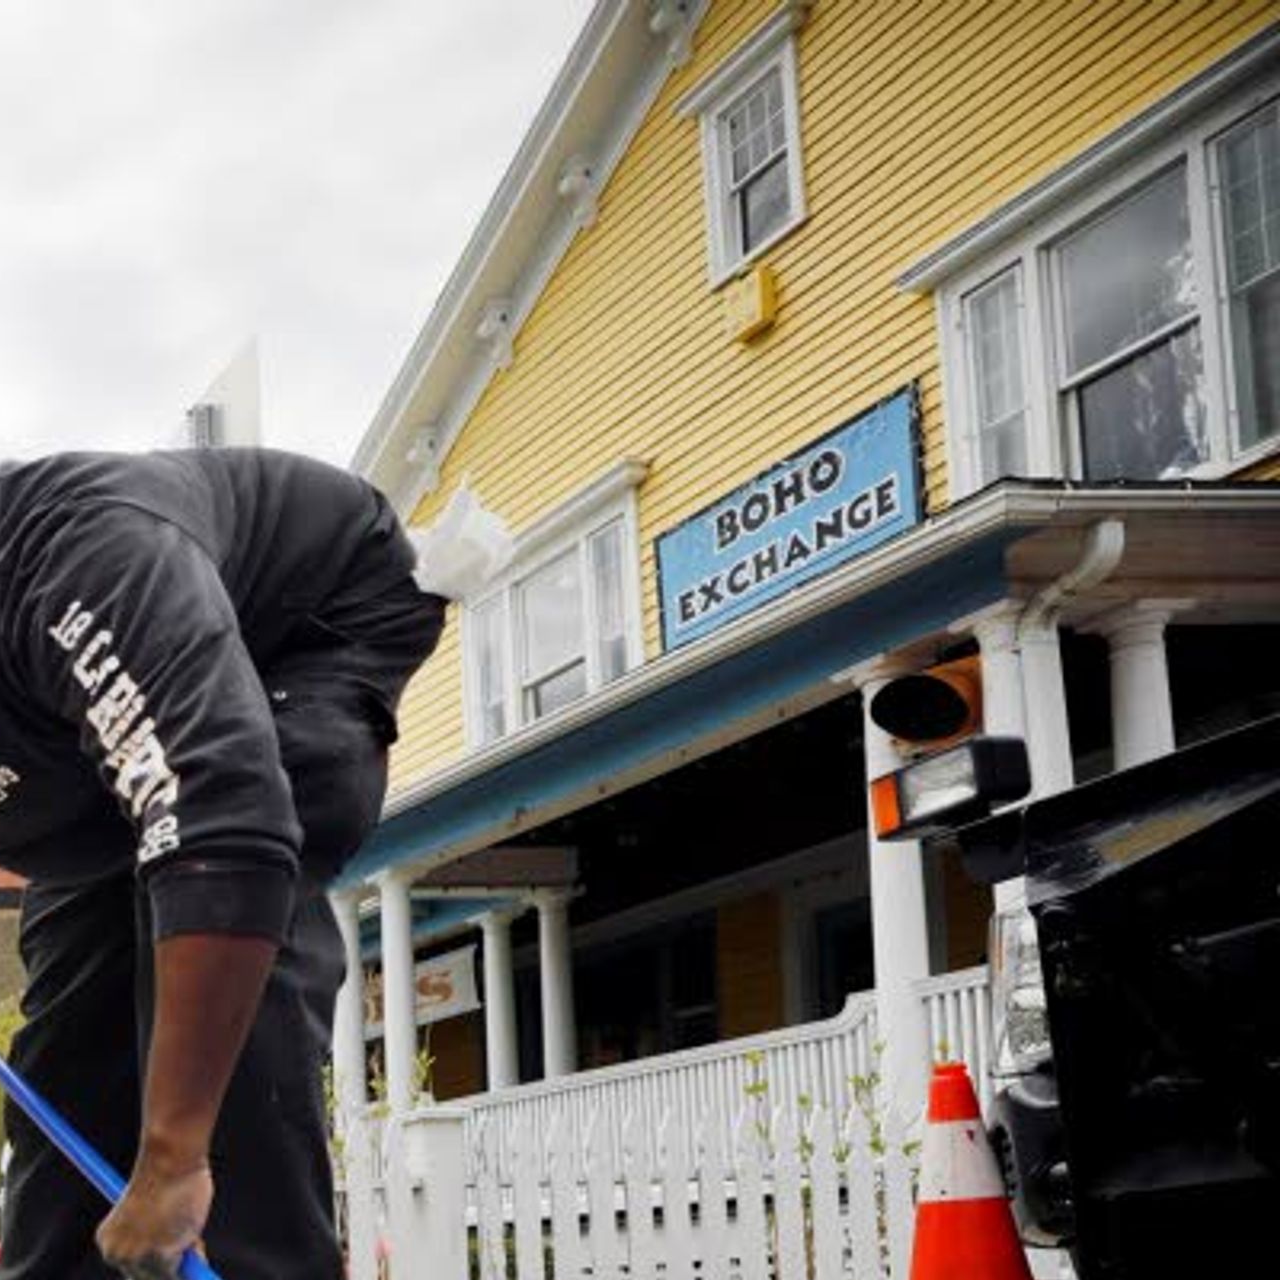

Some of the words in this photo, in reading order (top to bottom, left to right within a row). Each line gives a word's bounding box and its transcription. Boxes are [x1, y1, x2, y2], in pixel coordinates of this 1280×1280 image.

[715, 450, 842, 549] BOHO
[678, 478, 896, 622] EXCHANGE
[48, 600, 94, 650] 18
